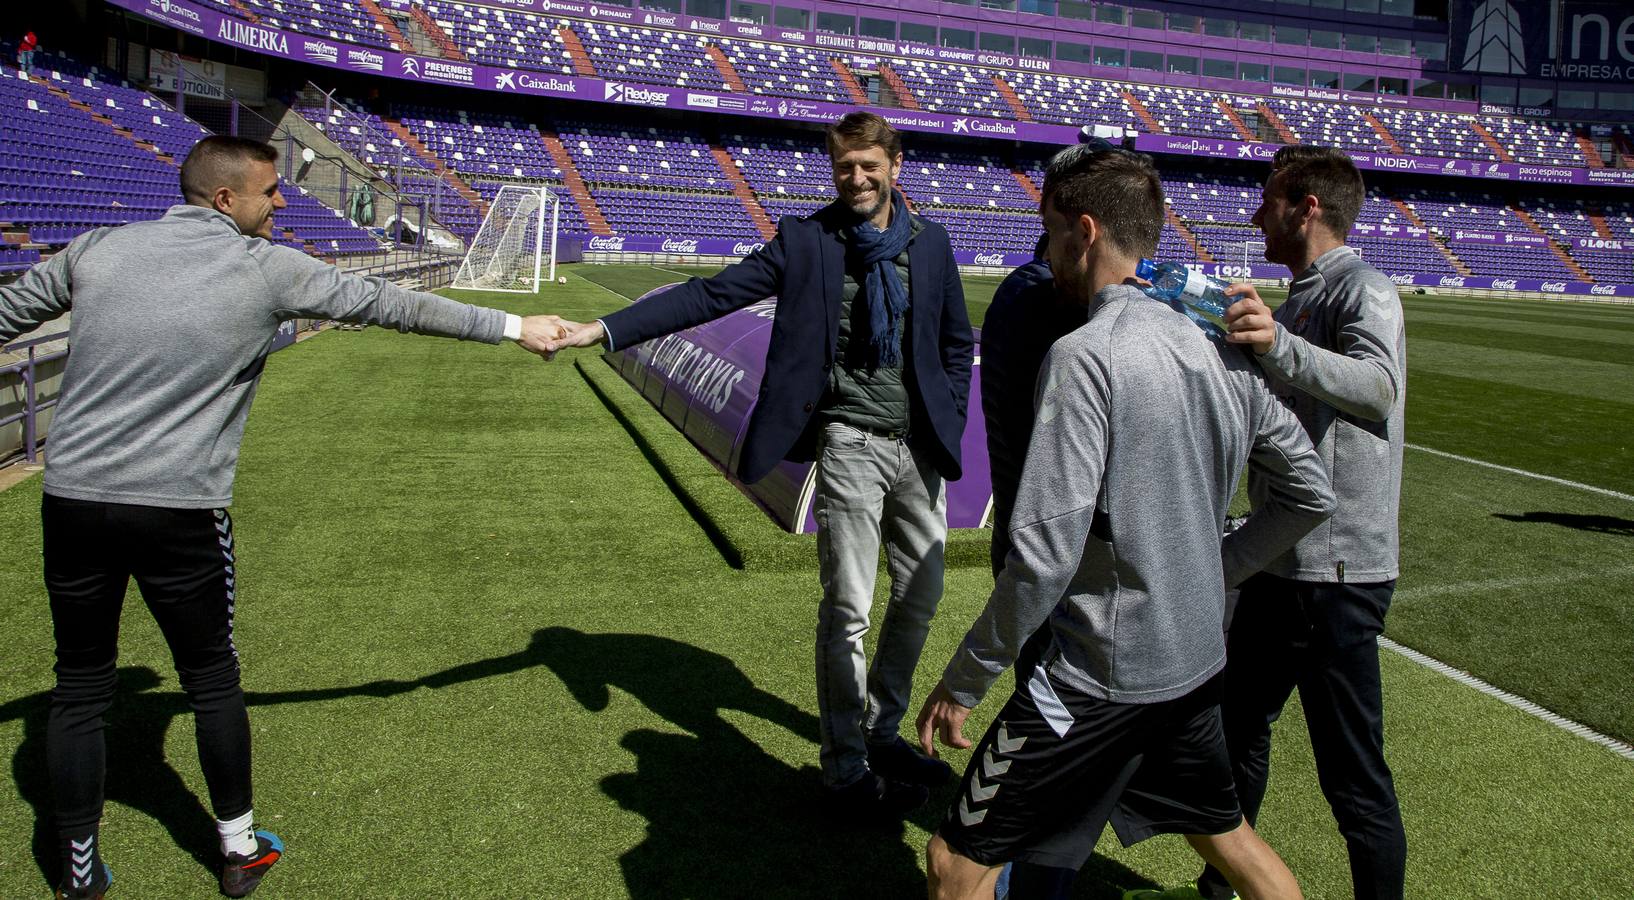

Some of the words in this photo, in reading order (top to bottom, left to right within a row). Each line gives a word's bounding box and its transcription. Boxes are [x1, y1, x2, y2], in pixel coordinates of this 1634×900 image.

[170, 4, 200, 22] CONTROL
[550, 3, 585, 12] RENAULT
[599, 9, 632, 19] RENAULT
[217, 18, 289, 54] ALIMERKA
[737, 26, 762, 35] crealia
[781, 31, 805, 41] crealia
[815, 35, 855, 48] RESTAURANTE
[858, 40, 876, 51] PEDRO
[911, 47, 935, 57] SOFÁS
[939, 50, 975, 61] GRANFORT
[425, 61, 473, 75] PREVENGES
[986, 55, 1014, 66] GRUPO
[1018, 58, 1050, 70] EULEN
[1541, 63, 1622, 79] EMPRESA
[518, 74, 576, 93] CaixaBank
[625, 87, 670, 102] Redyser
[692, 97, 714, 105] UEMC
[1524, 107, 1551, 117] GROUP
[918, 118, 940, 128] Isabel
[971, 120, 1016, 134] CaixaBank
[1374, 157, 1417, 169] INDIBA
[1538, 168, 1573, 177] espinosa
[1588, 170, 1621, 178] Ambrosio
[589, 236, 626, 250] Coca-Cola
[661, 238, 699, 253] Coca-Cola
[974, 252, 1006, 265] Coca-Cola
[1389, 273, 1415, 284] Coca-Cola
[1439, 275, 1466, 287] Coca-Cola
[1492, 278, 1518, 289] Coca-Cola
[1541, 281, 1568, 293] Coca-Cola
[1590, 284, 1617, 295] Coca-Cola
[651, 333, 703, 385] CUATRO
[685, 353, 745, 414] RAYAS
